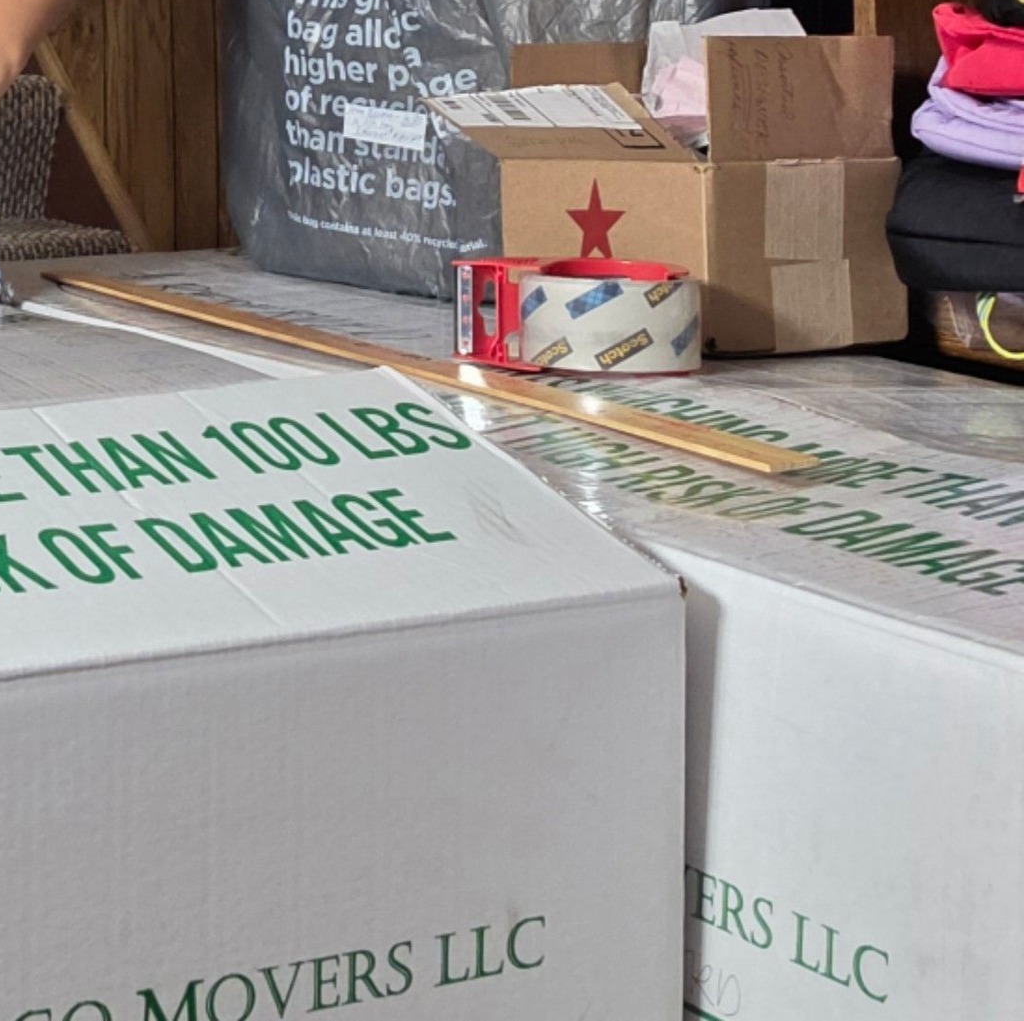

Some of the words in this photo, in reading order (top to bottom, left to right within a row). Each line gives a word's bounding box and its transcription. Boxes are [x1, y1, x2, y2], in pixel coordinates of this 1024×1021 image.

[287, 9, 339, 49] bag
[284, 45, 378, 85] higher
[285, 85, 313, 114] of
[285, 119, 345, 155] than
[288, 156, 376, 195] plastic
[386, 168, 457, 210] bags.
[598, 331, 650, 366] Scotch
[3, 430, 216, 496] THAN
[202, 416, 339, 474] 100
[316, 402, 472, 460] LBS
[39, 522, 143, 585] OF
[135, 488, 458, 574] DAMAGE
[687, 866, 774, 950] ERS
[789, 910, 890, 1004] LLC
[135, 940, 414, 1021] MOVERS
[433, 915, 546, 988] LLC
